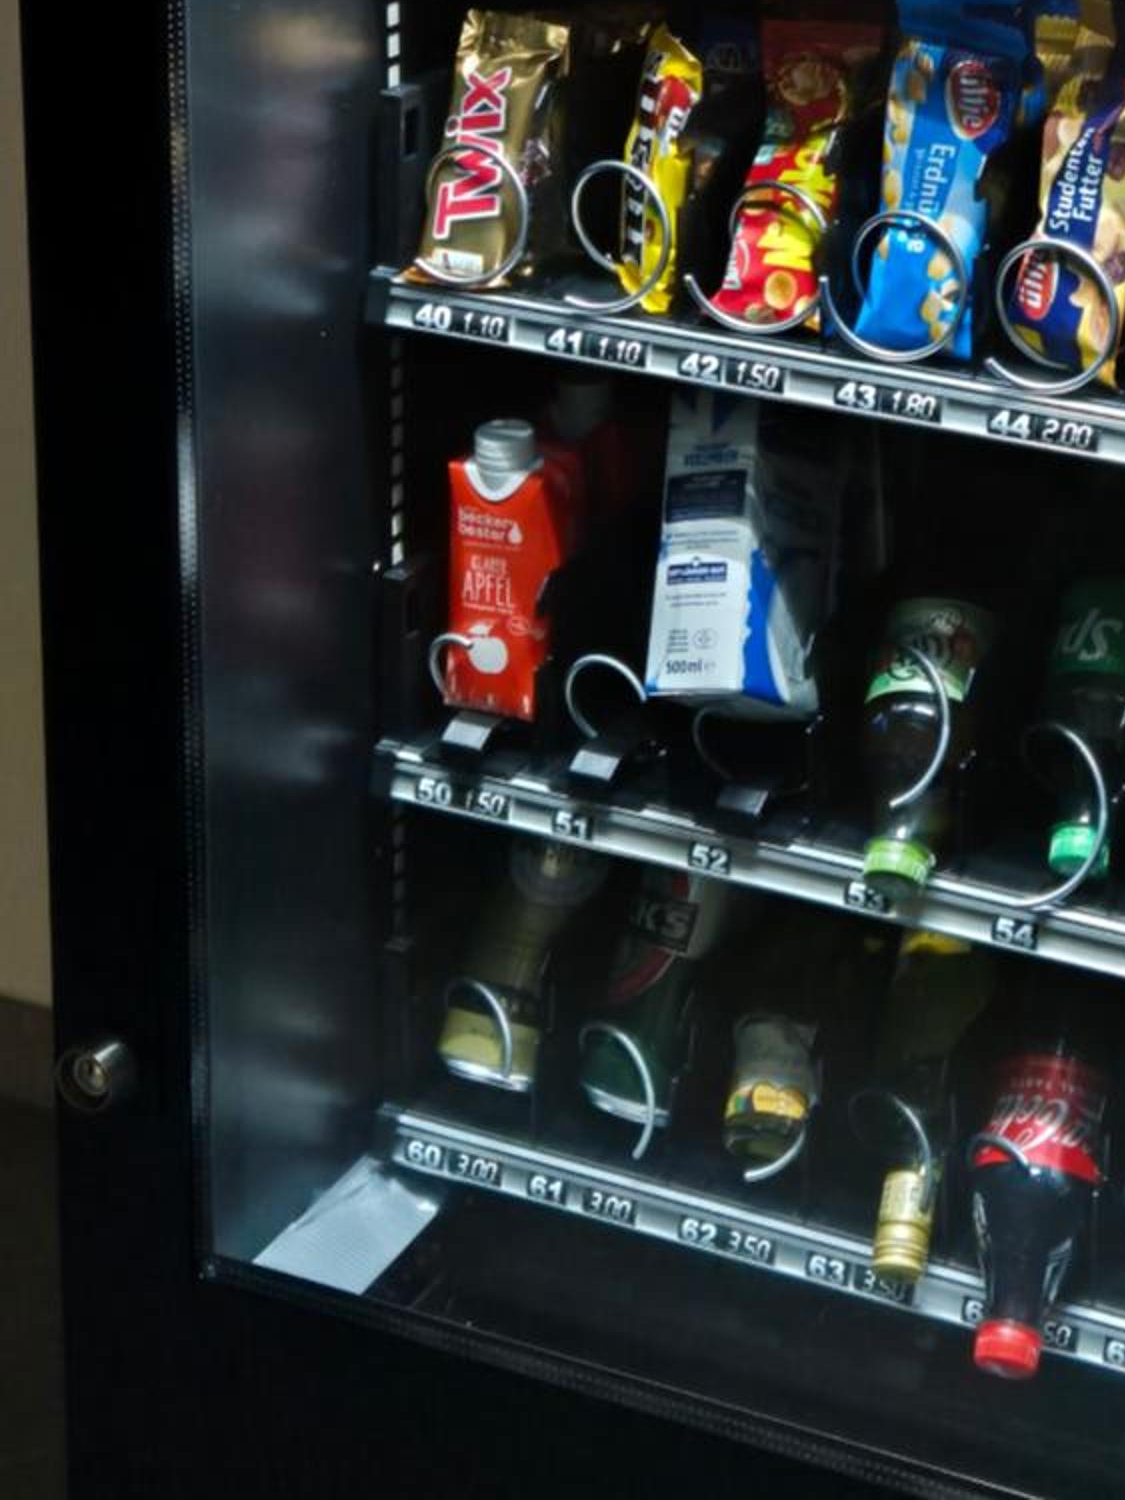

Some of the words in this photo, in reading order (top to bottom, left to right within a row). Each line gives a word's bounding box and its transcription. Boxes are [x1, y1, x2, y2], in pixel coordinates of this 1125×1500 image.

[1073, 155, 1104, 222] Futter
[415, 304, 449, 330] 40
[545, 328, 583, 353] 41
[680, 352, 719, 378] 42
[837, 381, 877, 409] 43
[989, 409, 1031, 439] 44
[463, 569, 513, 606] APFEL
[418, 777, 452, 805] 50
[555, 811, 588, 840] 51
[692, 844, 730, 872] 52
[847, 881, 885, 910] 53
[993, 918, 1034, 948] 54
[408, 1139, 442, 1166] 60
[529, 1175, 563, 1201] 61
[681, 1217, 717, 1246] 62
[808, 1255, 845, 1284] 63
[965, 1300, 985, 1323] 6
